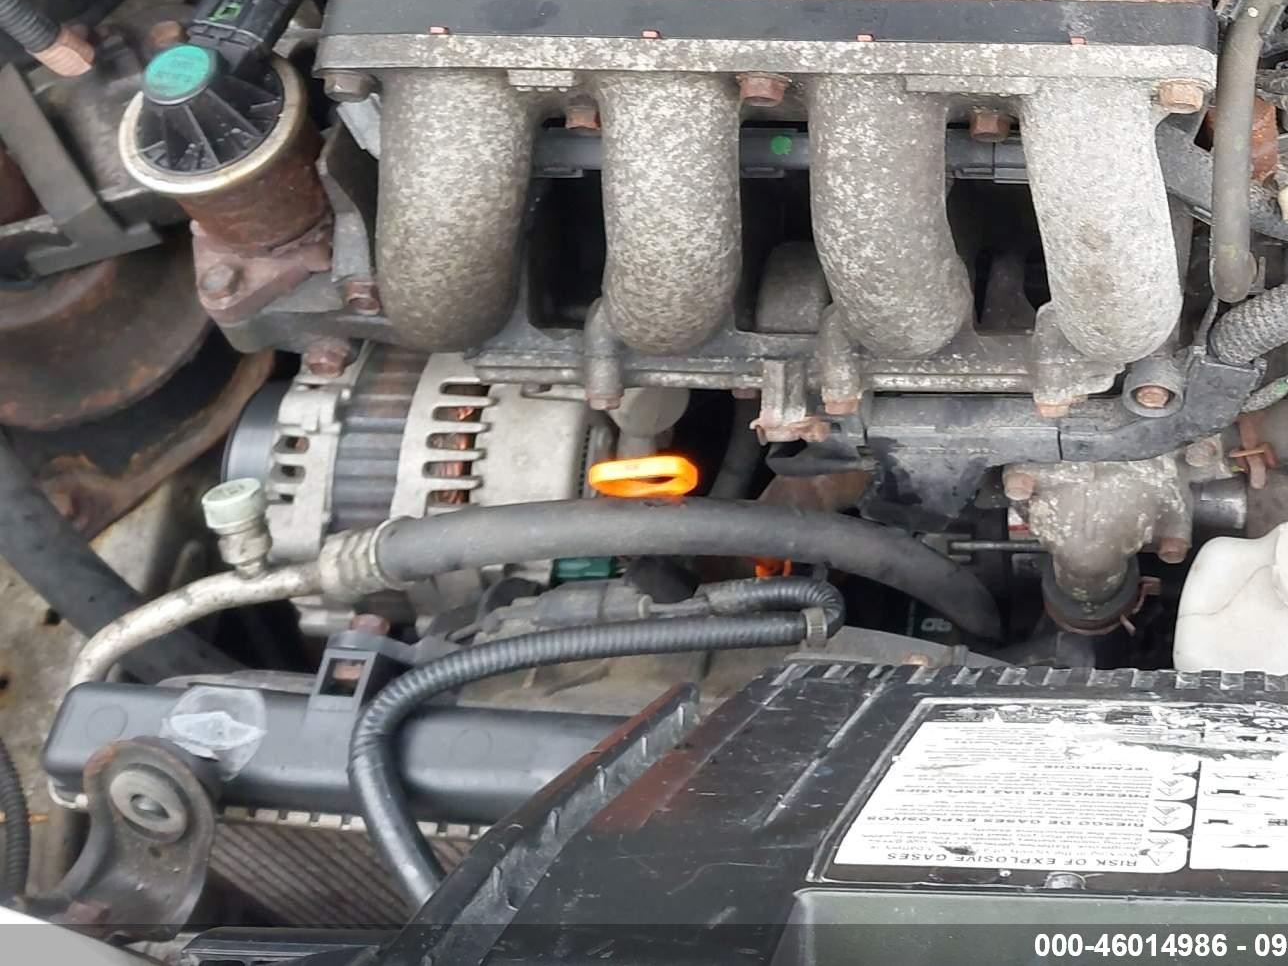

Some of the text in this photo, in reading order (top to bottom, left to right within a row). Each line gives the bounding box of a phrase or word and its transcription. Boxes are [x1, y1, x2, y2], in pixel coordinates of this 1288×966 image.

[887, 852, 1138, 867] RISK OF EXPLOSIVE GASES
